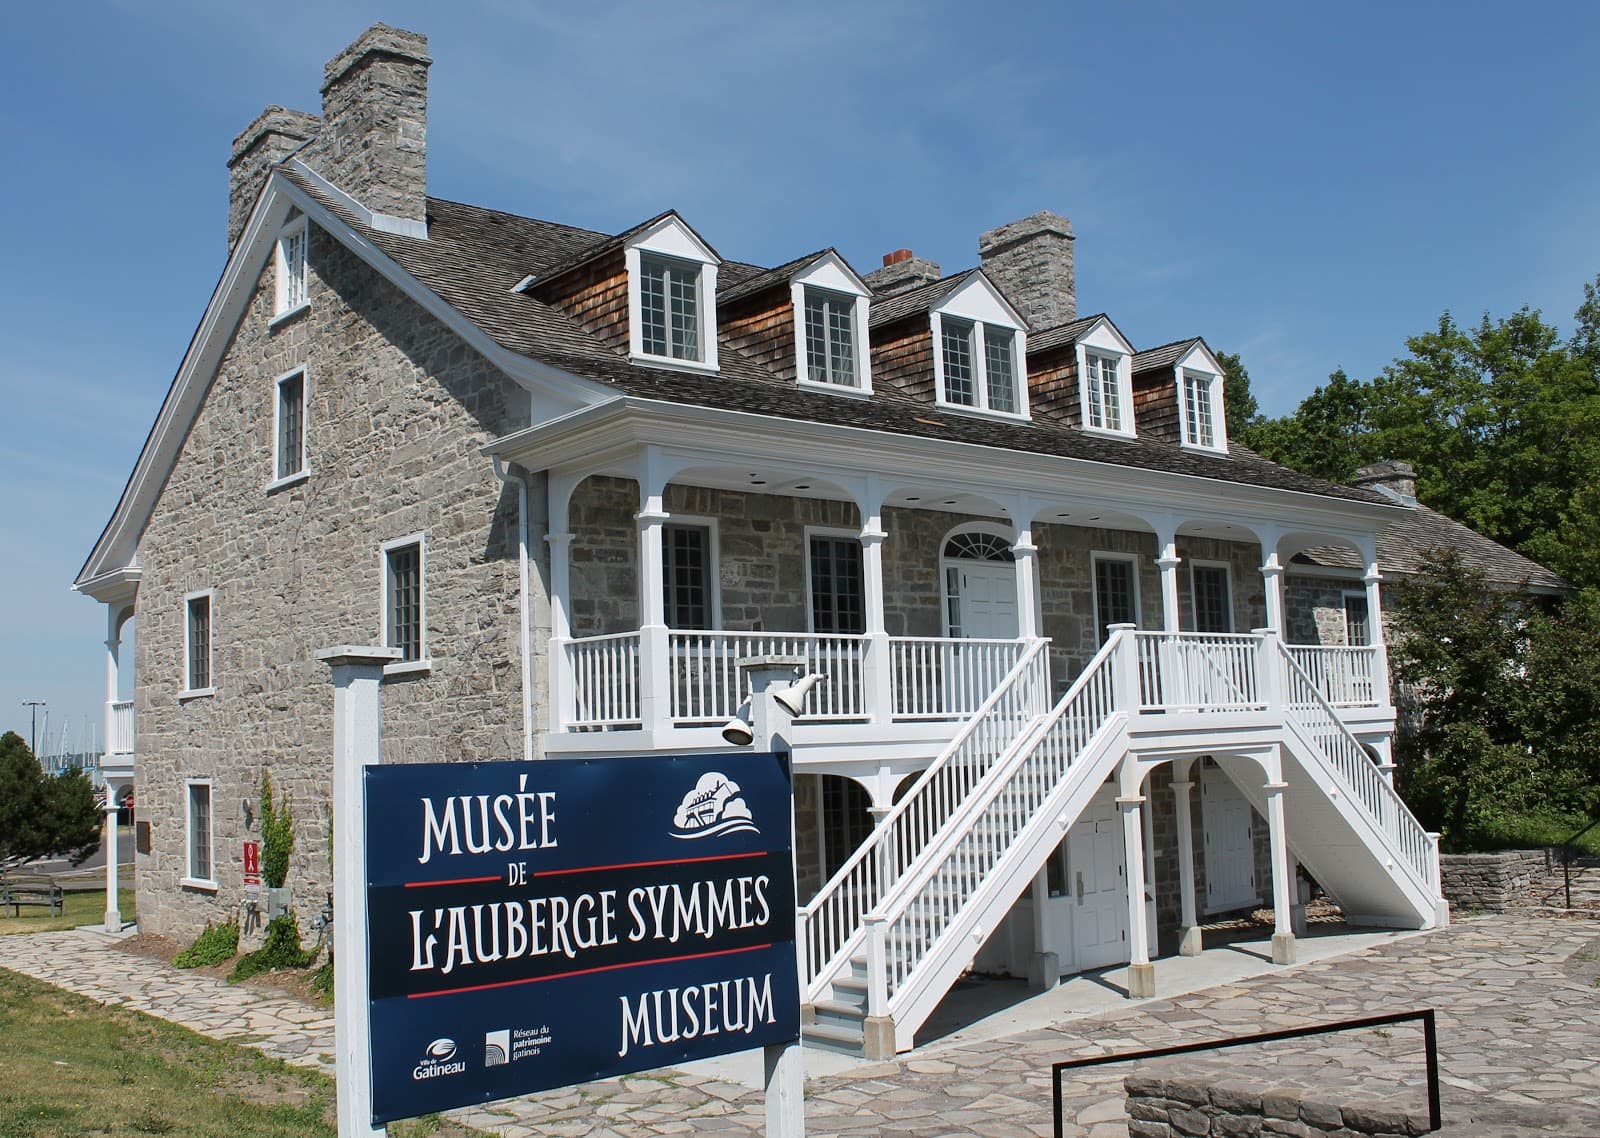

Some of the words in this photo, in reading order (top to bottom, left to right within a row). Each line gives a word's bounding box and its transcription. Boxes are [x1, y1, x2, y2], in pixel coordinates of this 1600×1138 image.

[417, 773, 558, 865] MUSÉE
[508, 862, 528, 887] DE
[408, 890, 619, 974] L'AUBERGE
[627, 875, 770, 943] SYMMES
[618, 973, 777, 1058] MUSEUM
[513, 1028, 539, 1039] Réseau
[540, 1024, 550, 1034] du
[512, 1047, 541, 1061] gatinois
[513, 1035, 552, 1051] patrimoine
[412, 1061, 466, 1080] Gatineau
